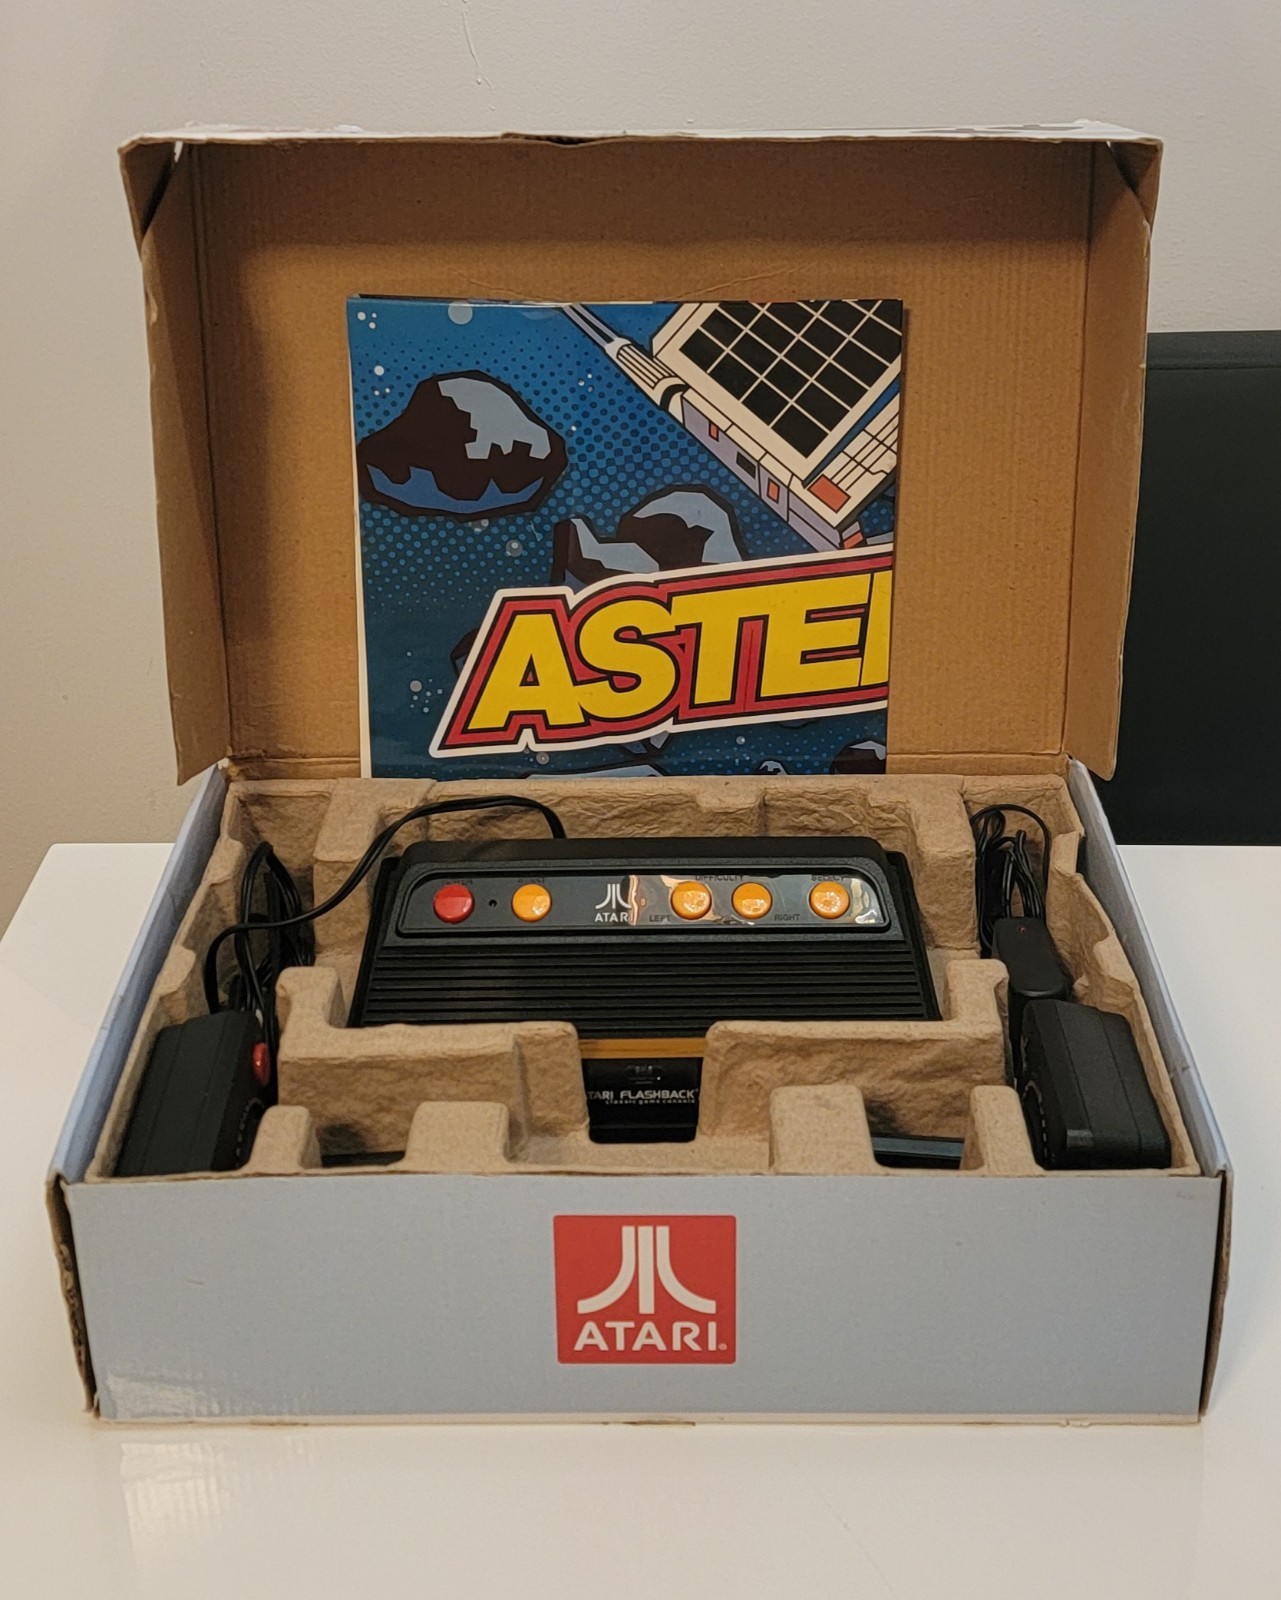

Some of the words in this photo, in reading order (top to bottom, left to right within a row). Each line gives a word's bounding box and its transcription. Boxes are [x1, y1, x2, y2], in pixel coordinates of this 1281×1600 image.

[695, 874, 744, 882] DIFFICULTY
[811, 874, 845, 882] SELECT
[649, 914, 671, 923] LEFT
[774, 913, 801, 922] RIGHT
[586, 1090, 614, 1100] TARI
[620, 1089, 695, 1099] FLASHBACK
[573, 1320, 718, 1352] ATARI
